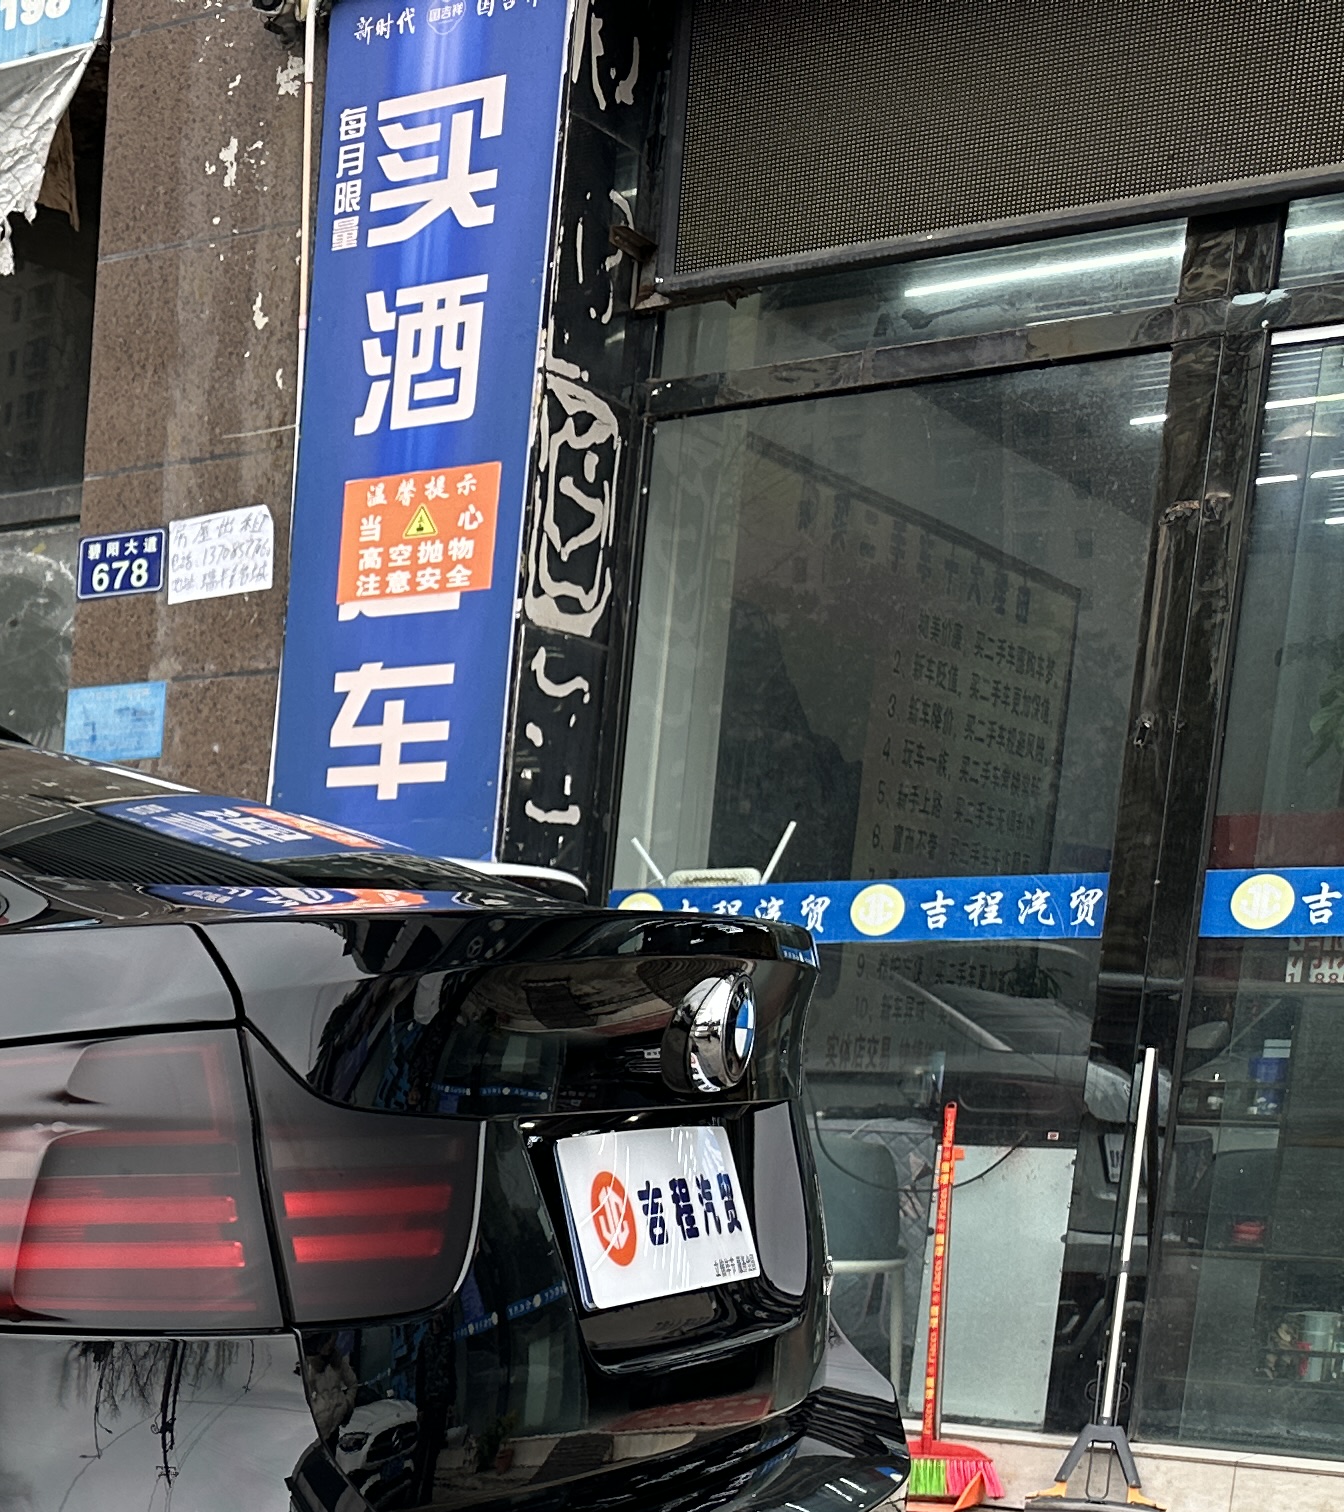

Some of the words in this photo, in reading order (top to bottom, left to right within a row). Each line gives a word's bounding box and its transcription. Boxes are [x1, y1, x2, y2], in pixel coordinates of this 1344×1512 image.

[354, 7, 416, 45] 新时代
[331, 107, 369, 251] 每月限量
[325, 74, 507, 800] 买酒车
[366, 473, 478, 507] 温馨提示
[358, 537, 475, 571] 高空抛物
[92, 558, 148, 592] 678
[356, 564, 472, 597] 注意安全
[920, 886, 1103, 930] 吉程汽贸
[1302, 881, 1343, 925] 吉
[637, 1173, 742, 1246] 吉程汽贸
